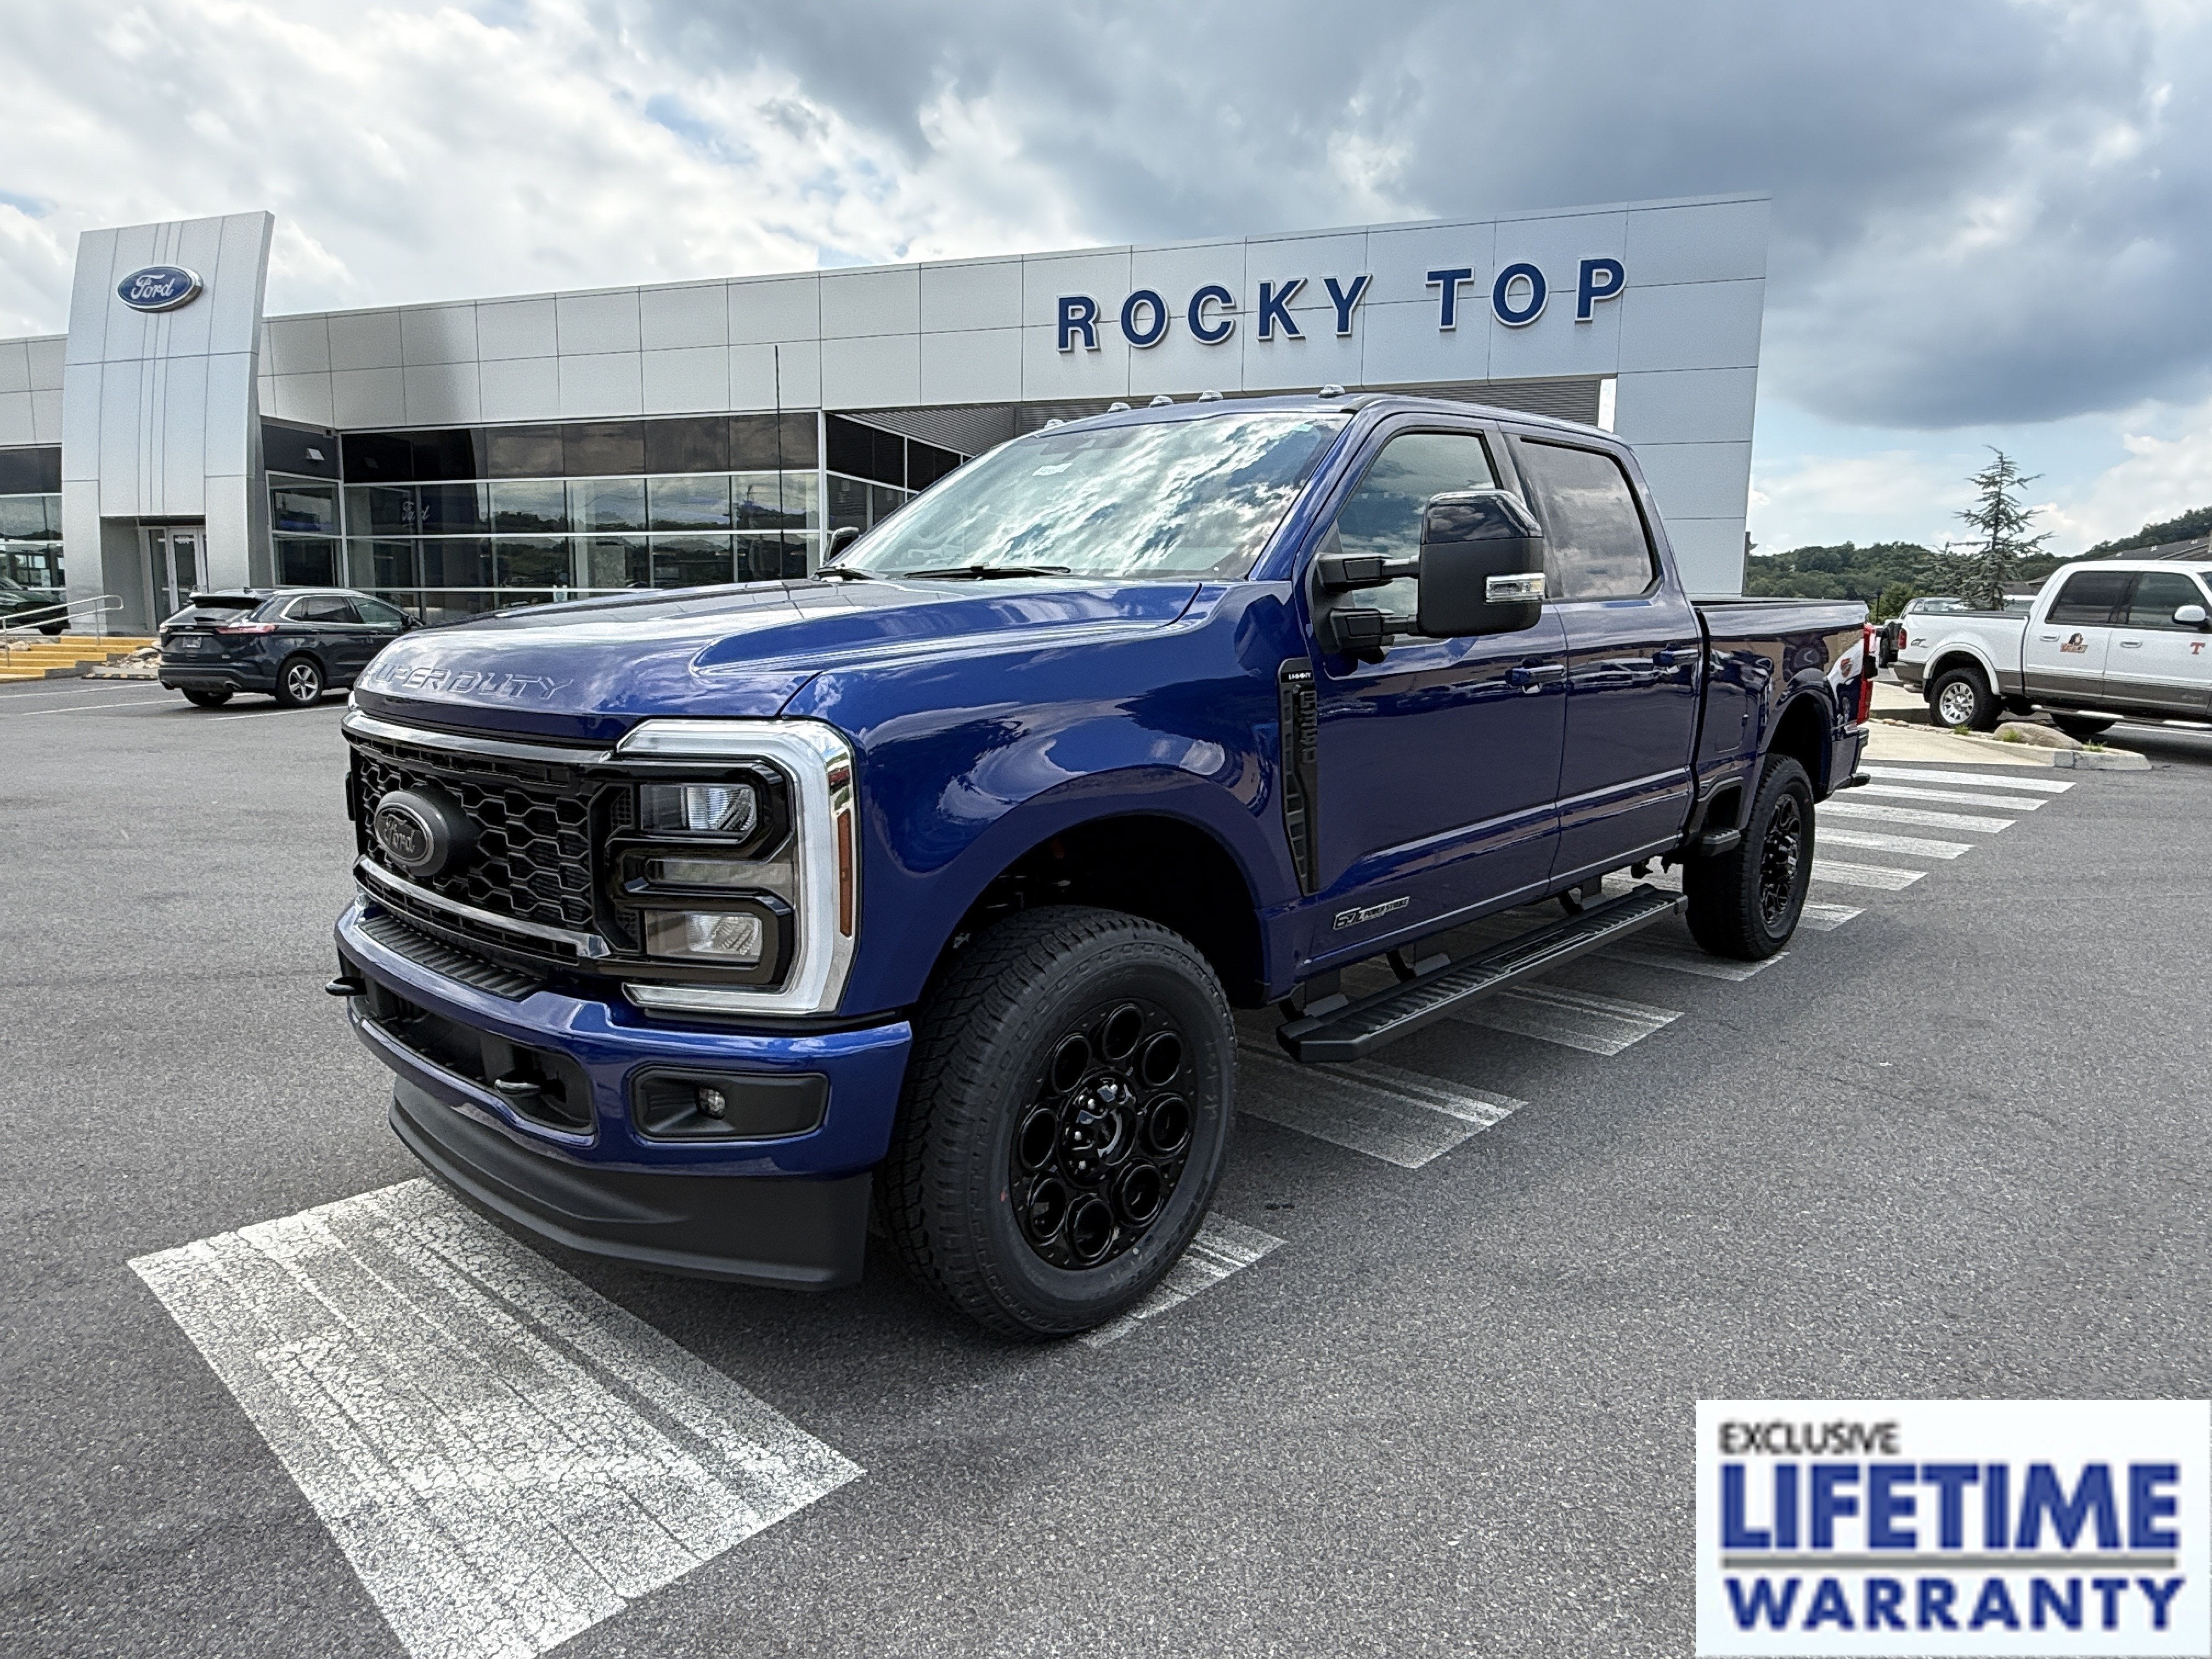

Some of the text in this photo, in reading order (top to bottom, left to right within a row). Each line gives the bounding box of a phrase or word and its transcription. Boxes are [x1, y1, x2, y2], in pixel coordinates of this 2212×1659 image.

[131, 274, 176, 300] Ford
[1057, 258, 1627, 352] ROCKY TOP
[402, 501, 430, 521] Fod
[2190, 642, 2205, 654] T
[445, 670, 575, 700] DUTY
[384, 814, 415, 853] Ford
